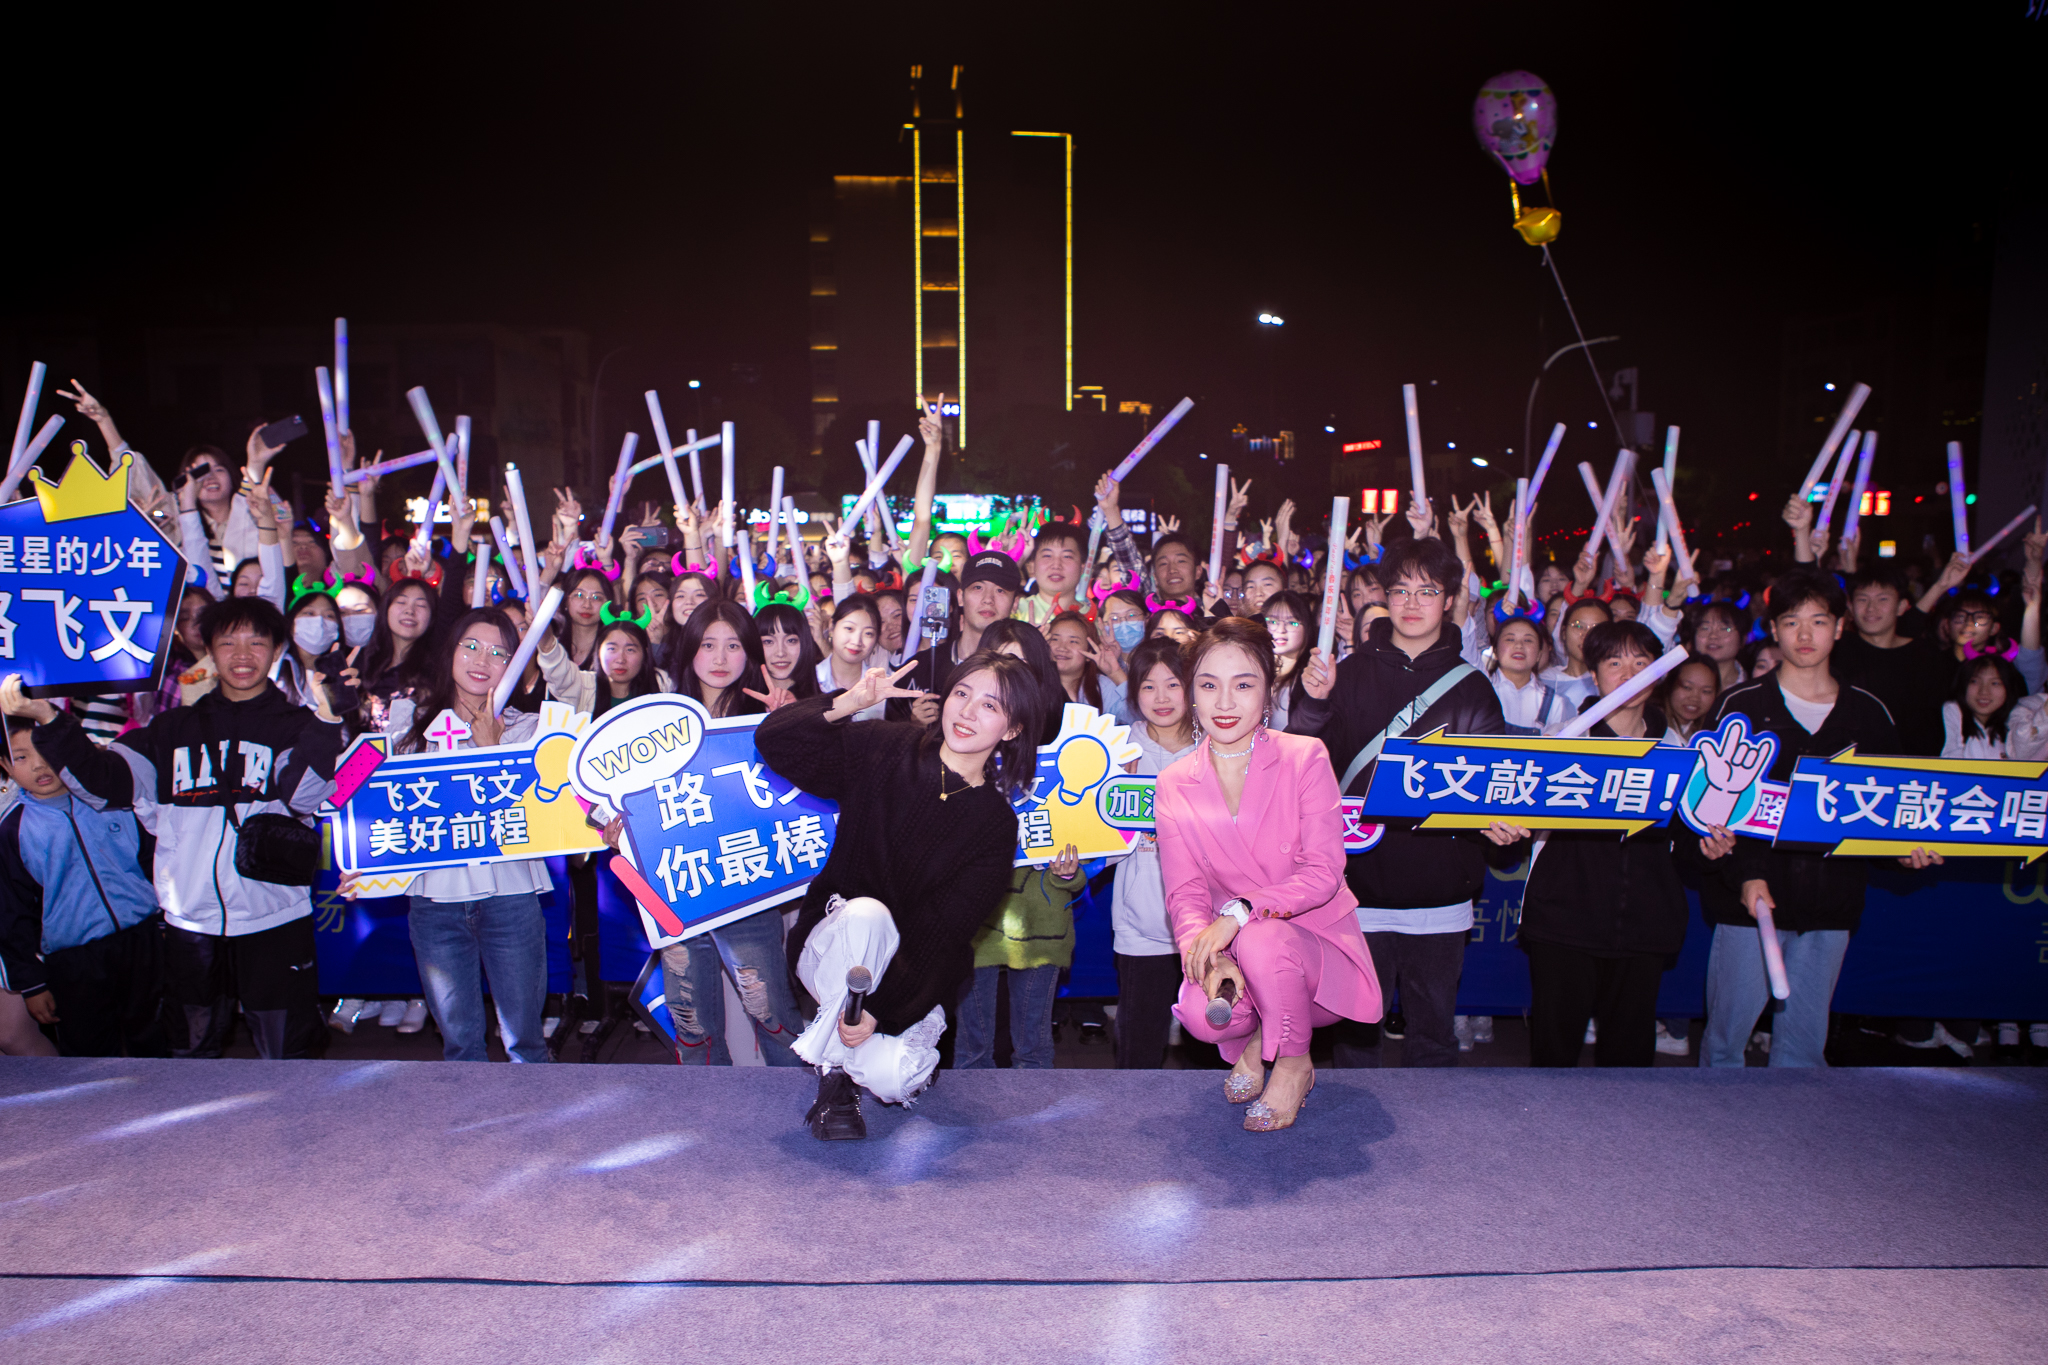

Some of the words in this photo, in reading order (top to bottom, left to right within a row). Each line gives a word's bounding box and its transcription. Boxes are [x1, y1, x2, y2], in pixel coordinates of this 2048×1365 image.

[588, 715, 691, 781] WOW
[369, 777, 441, 813] 飞文
[451, 768, 523, 805] 飞文
[653, 760, 802, 831] 路飞
[1377, 754, 1681, 814] 飞文敲会唱!
[1792, 773, 2048, 837] 飞文敲会唱
[368, 807, 530, 858] 美好前程
[655, 813, 840, 903] 你最棒
